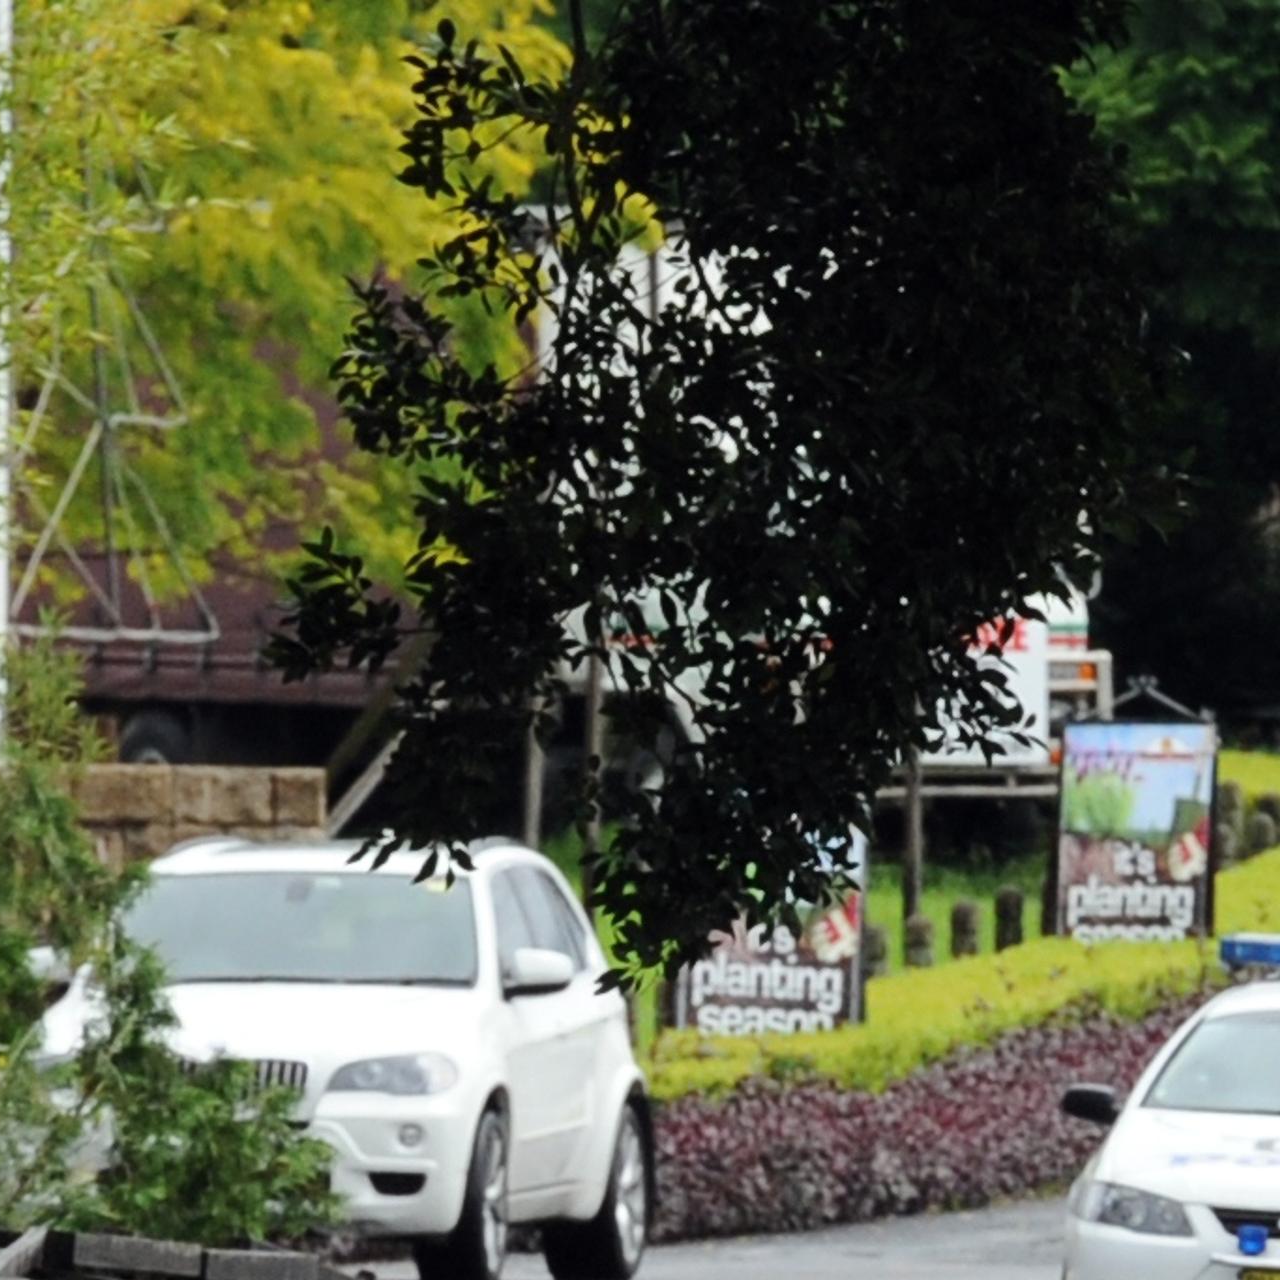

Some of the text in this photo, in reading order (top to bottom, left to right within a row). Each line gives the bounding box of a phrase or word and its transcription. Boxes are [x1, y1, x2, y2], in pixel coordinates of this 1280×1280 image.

[1067, 874, 1194, 929] planting
[691, 951, 843, 1014] planting
[697, 1004, 834, 1037] season
